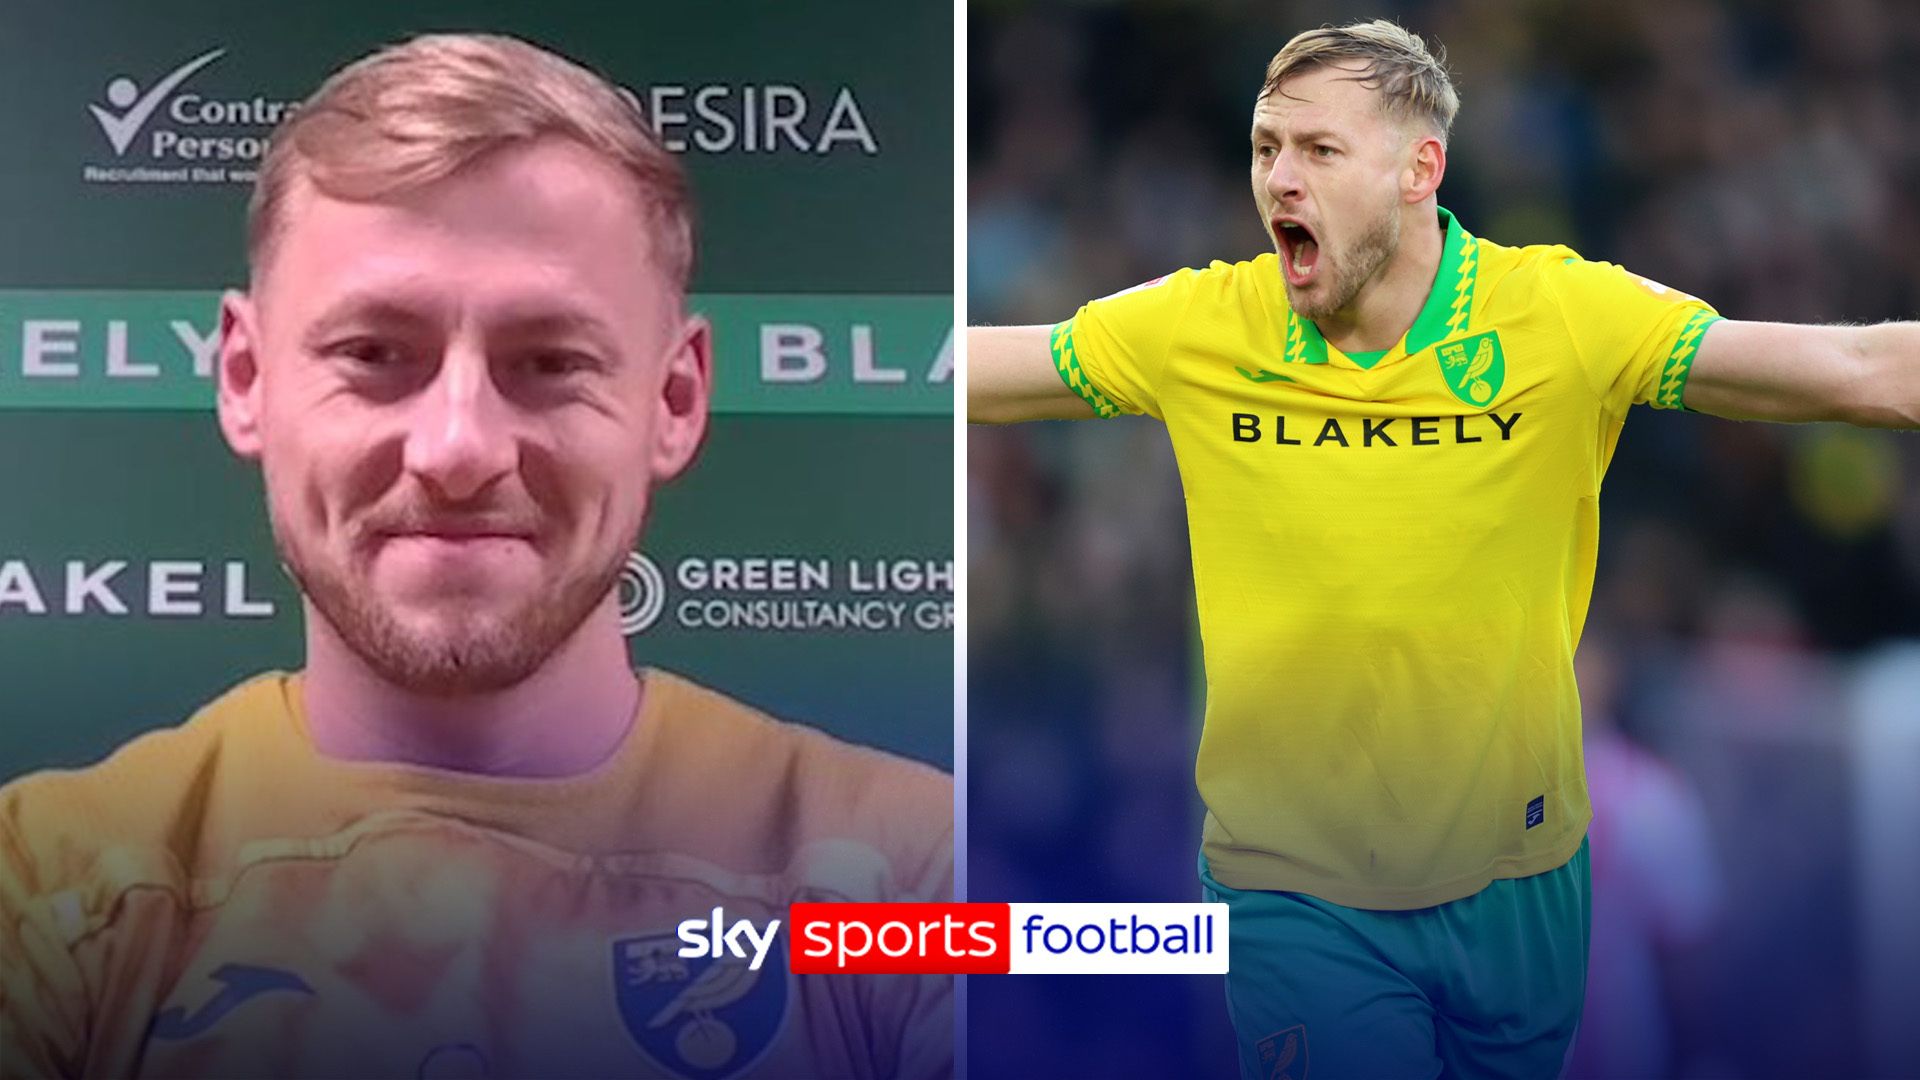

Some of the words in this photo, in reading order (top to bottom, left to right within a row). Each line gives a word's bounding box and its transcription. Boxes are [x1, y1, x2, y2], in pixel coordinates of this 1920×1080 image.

[616, 86, 878, 153] ESIRA
[192, 167, 225, 182] that
[22, 320, 221, 377] ELY
[1232, 412, 1522, 448] BLAKELY
[0, 560, 300, 614] AKEL
[677, 558, 830, 590] GREEN
[850, 560, 954, 591] LIGH
[677, 600, 906, 629] CONSULTANCY
